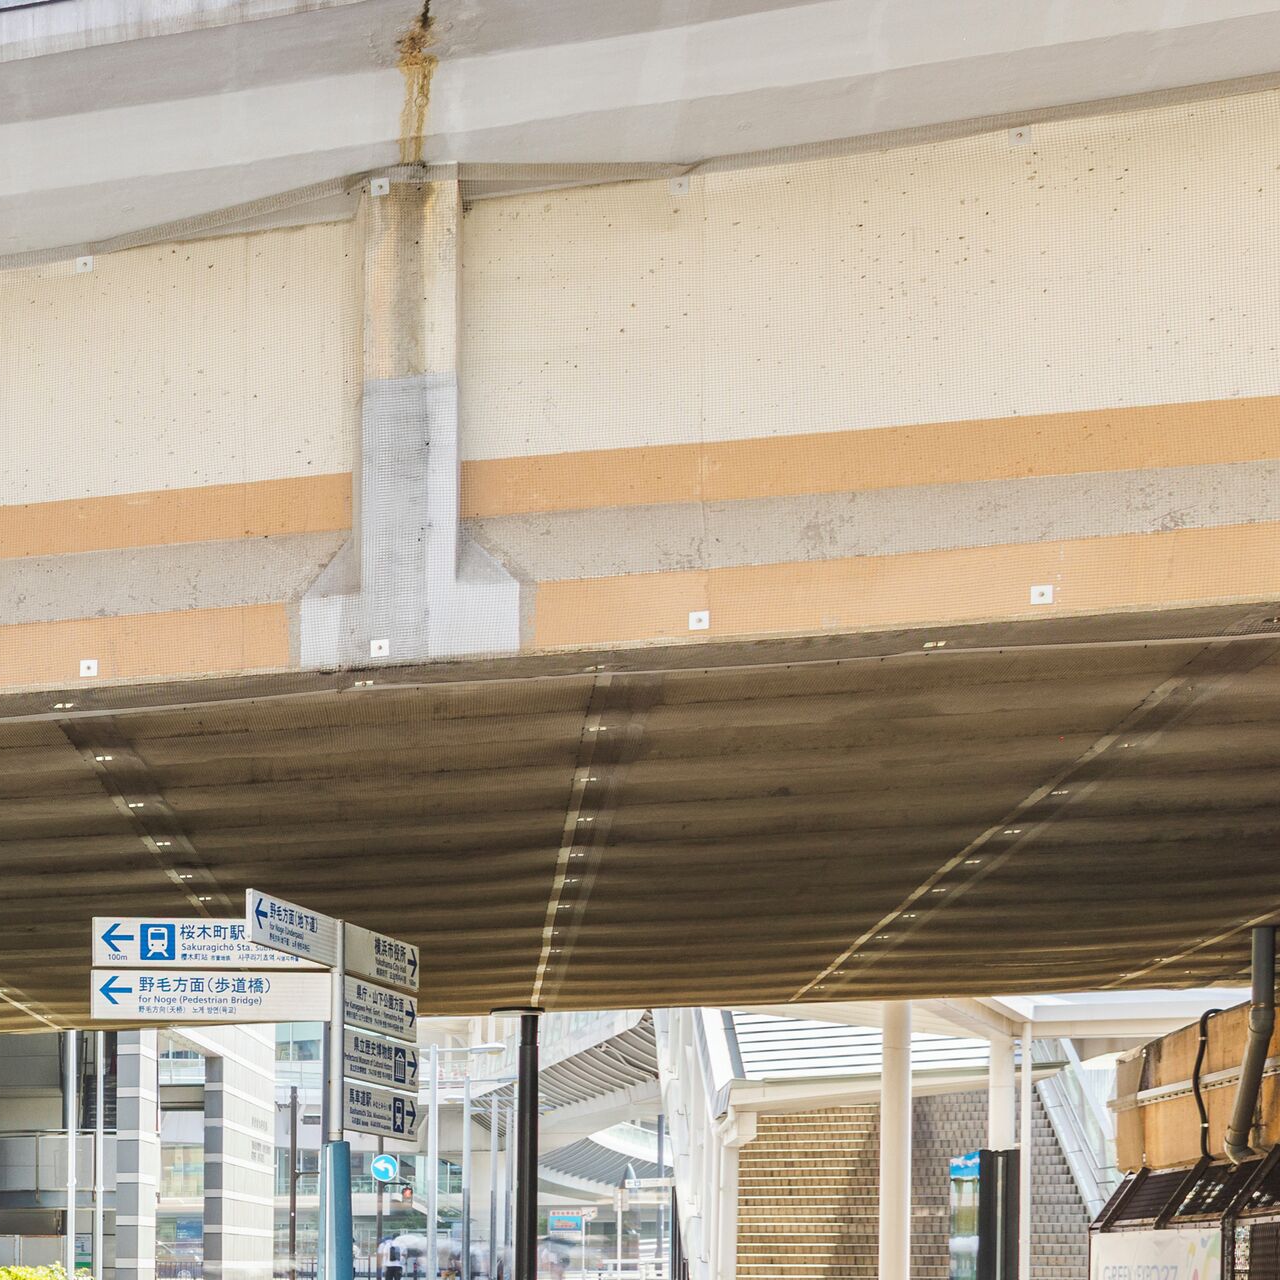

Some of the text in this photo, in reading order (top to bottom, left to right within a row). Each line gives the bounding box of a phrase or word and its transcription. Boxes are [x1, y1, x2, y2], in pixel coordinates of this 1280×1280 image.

[179, 923, 246, 941] 桜木町駅
[237, 943, 253, 952] Sta.
[107, 953, 128, 961] 100m
[138, 995, 262, 1006] for Noge (Pedestrian Bridge)
[349, 1087, 372, 1107] 馬車道駅
